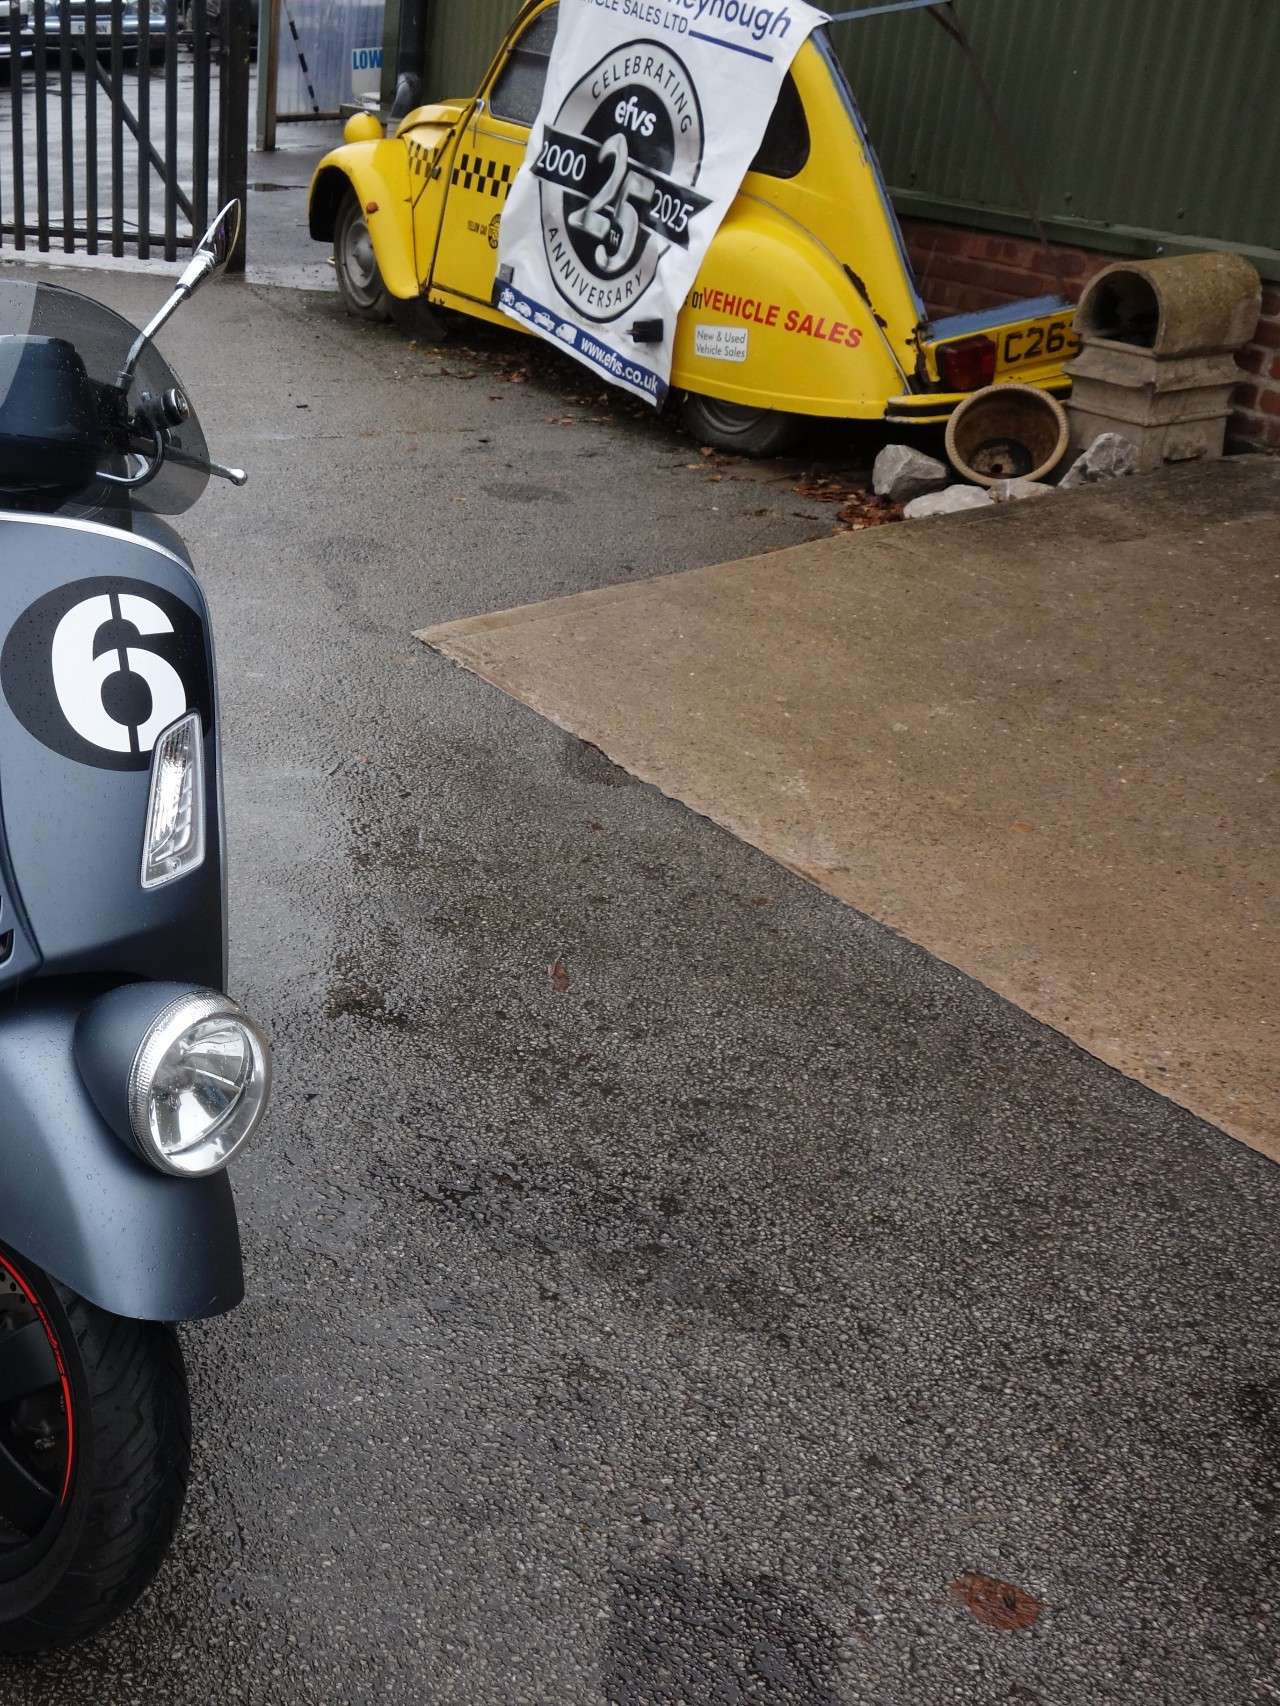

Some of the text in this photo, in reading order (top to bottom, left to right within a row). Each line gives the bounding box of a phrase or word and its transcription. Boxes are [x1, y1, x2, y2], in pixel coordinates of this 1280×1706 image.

[622, 0, 662, 25] SALES
[663, 11, 689, 34] LTD
[591, 55, 693, 134] CELEBRATING
[614, 95, 657, 137] efvs
[536, 141, 587, 182] 2000
[649, 189, 695, 233] 2025
[548, 227, 642, 309] ANNIVERSARY
[696, 330, 714, 341] New
[724, 331, 746, 344] Used
[703, 287, 864, 349] VEHICLE SALES
[580, 337, 659, 394] www.efvs.co.uk
[696, 343, 745, 358] Vehicle Sales
[51, 592, 187, 753] 6
